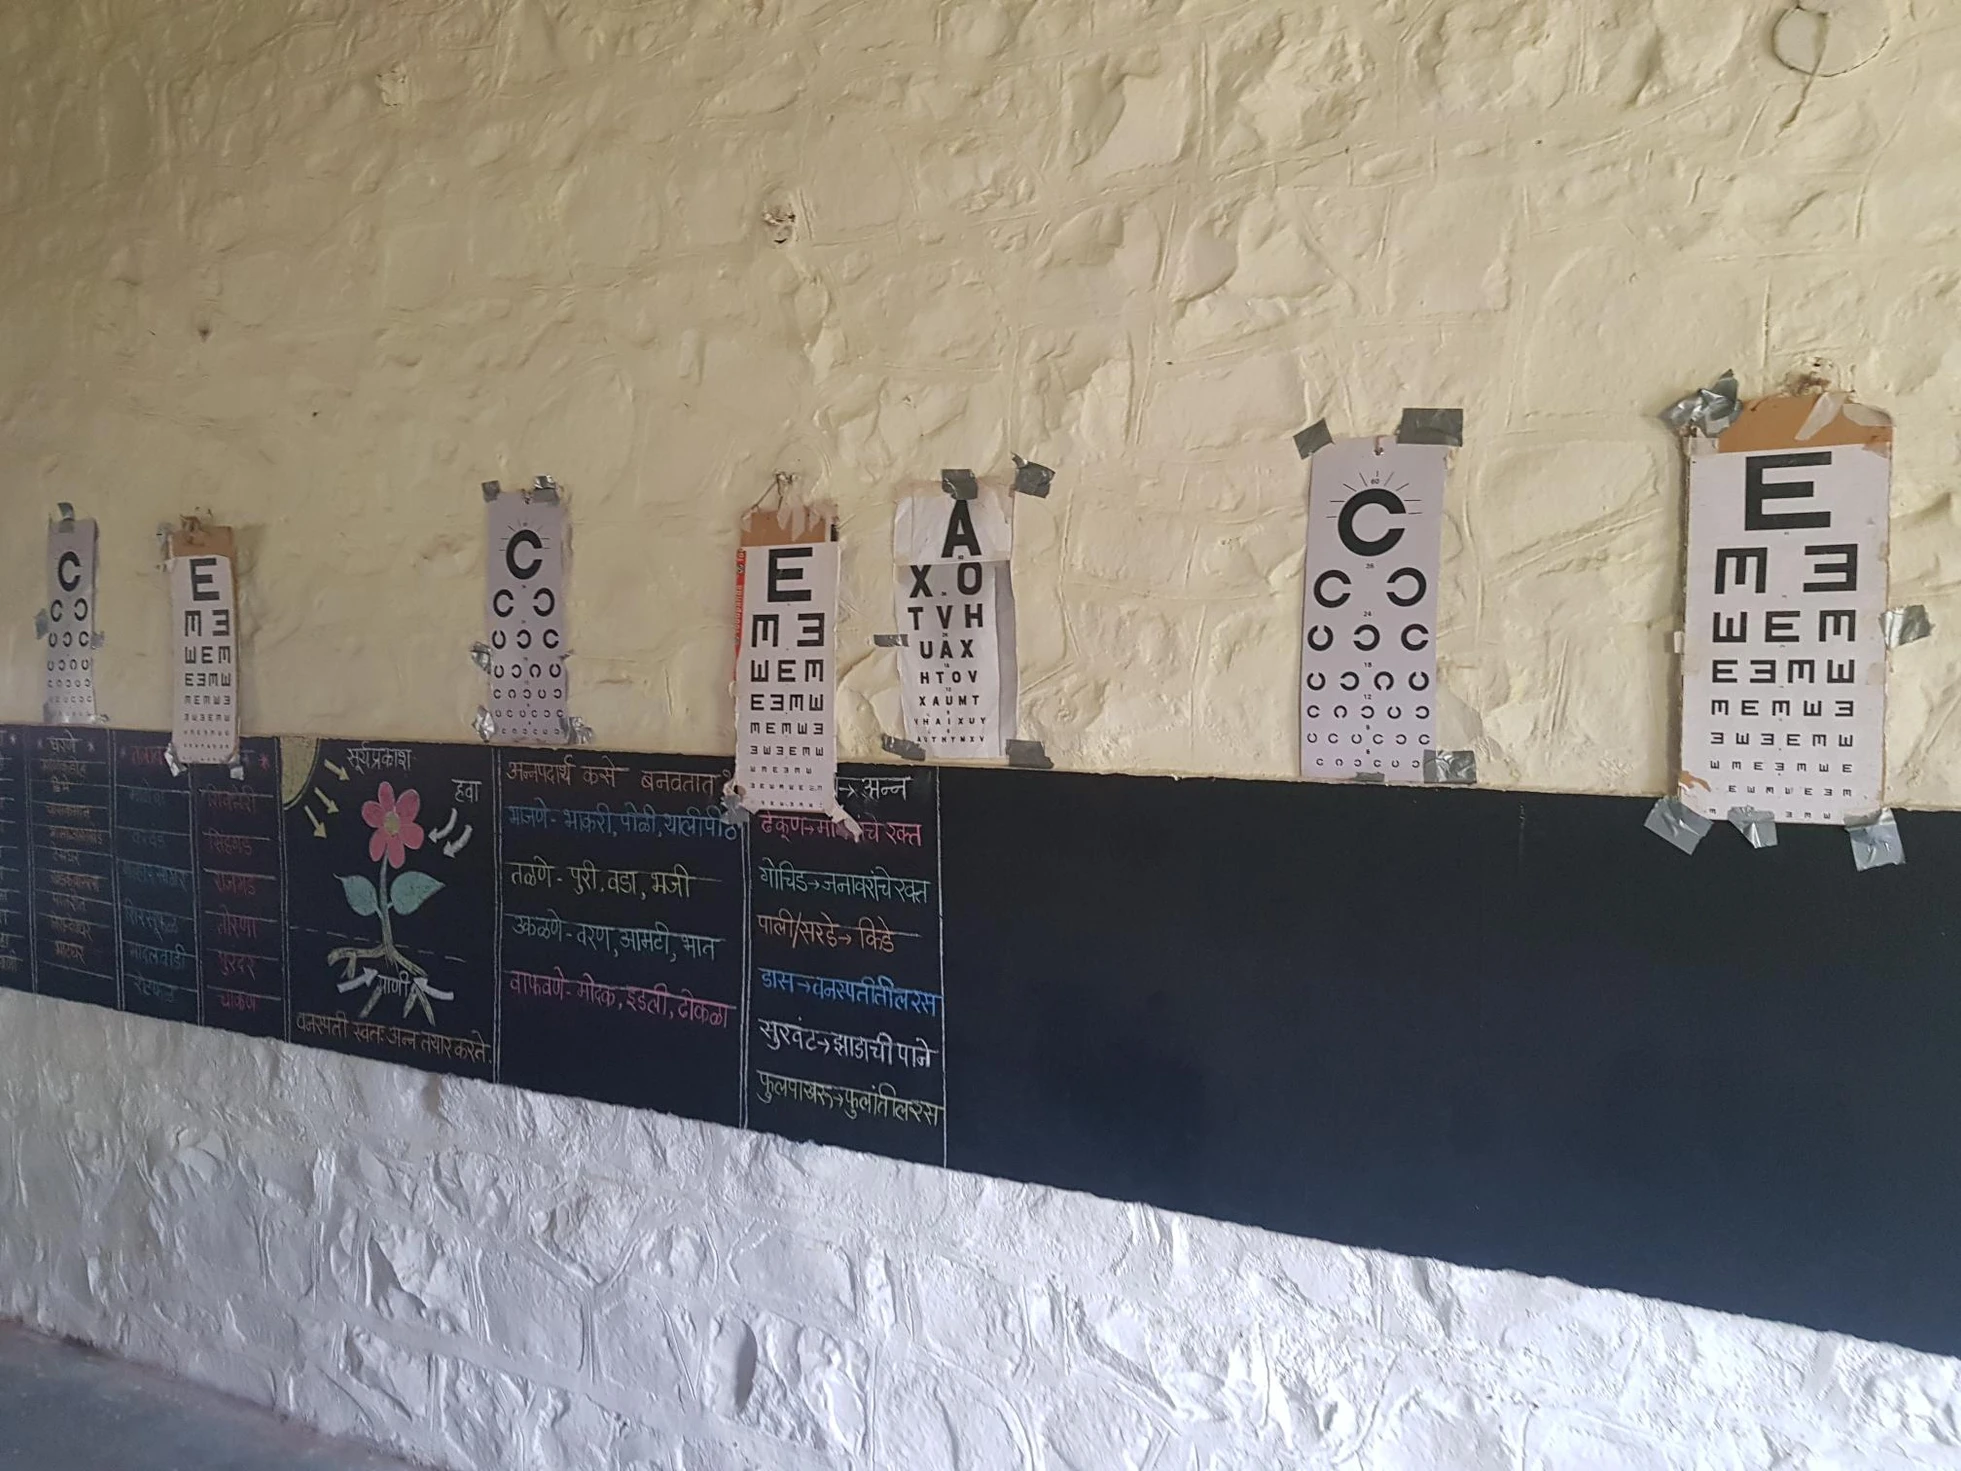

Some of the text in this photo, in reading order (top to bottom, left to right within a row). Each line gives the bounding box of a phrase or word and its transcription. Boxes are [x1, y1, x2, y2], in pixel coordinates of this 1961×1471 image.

[1744, 451, 1832, 531] E
[941, 499, 982, 558] A
[1338, 488, 1407, 557] C
[57, 551, 81, 592] C
[506, 529, 543, 580] C
[768, 547, 813, 602] E
[190, 557, 220, 602] E
[909, 562, 983, 598] X O
[451, 779, 483, 803] हवा
[580, 755, 631, 788] कसे
[640, 768, 722, 795] बनवतात
[861, 776, 914, 801] अन्न
